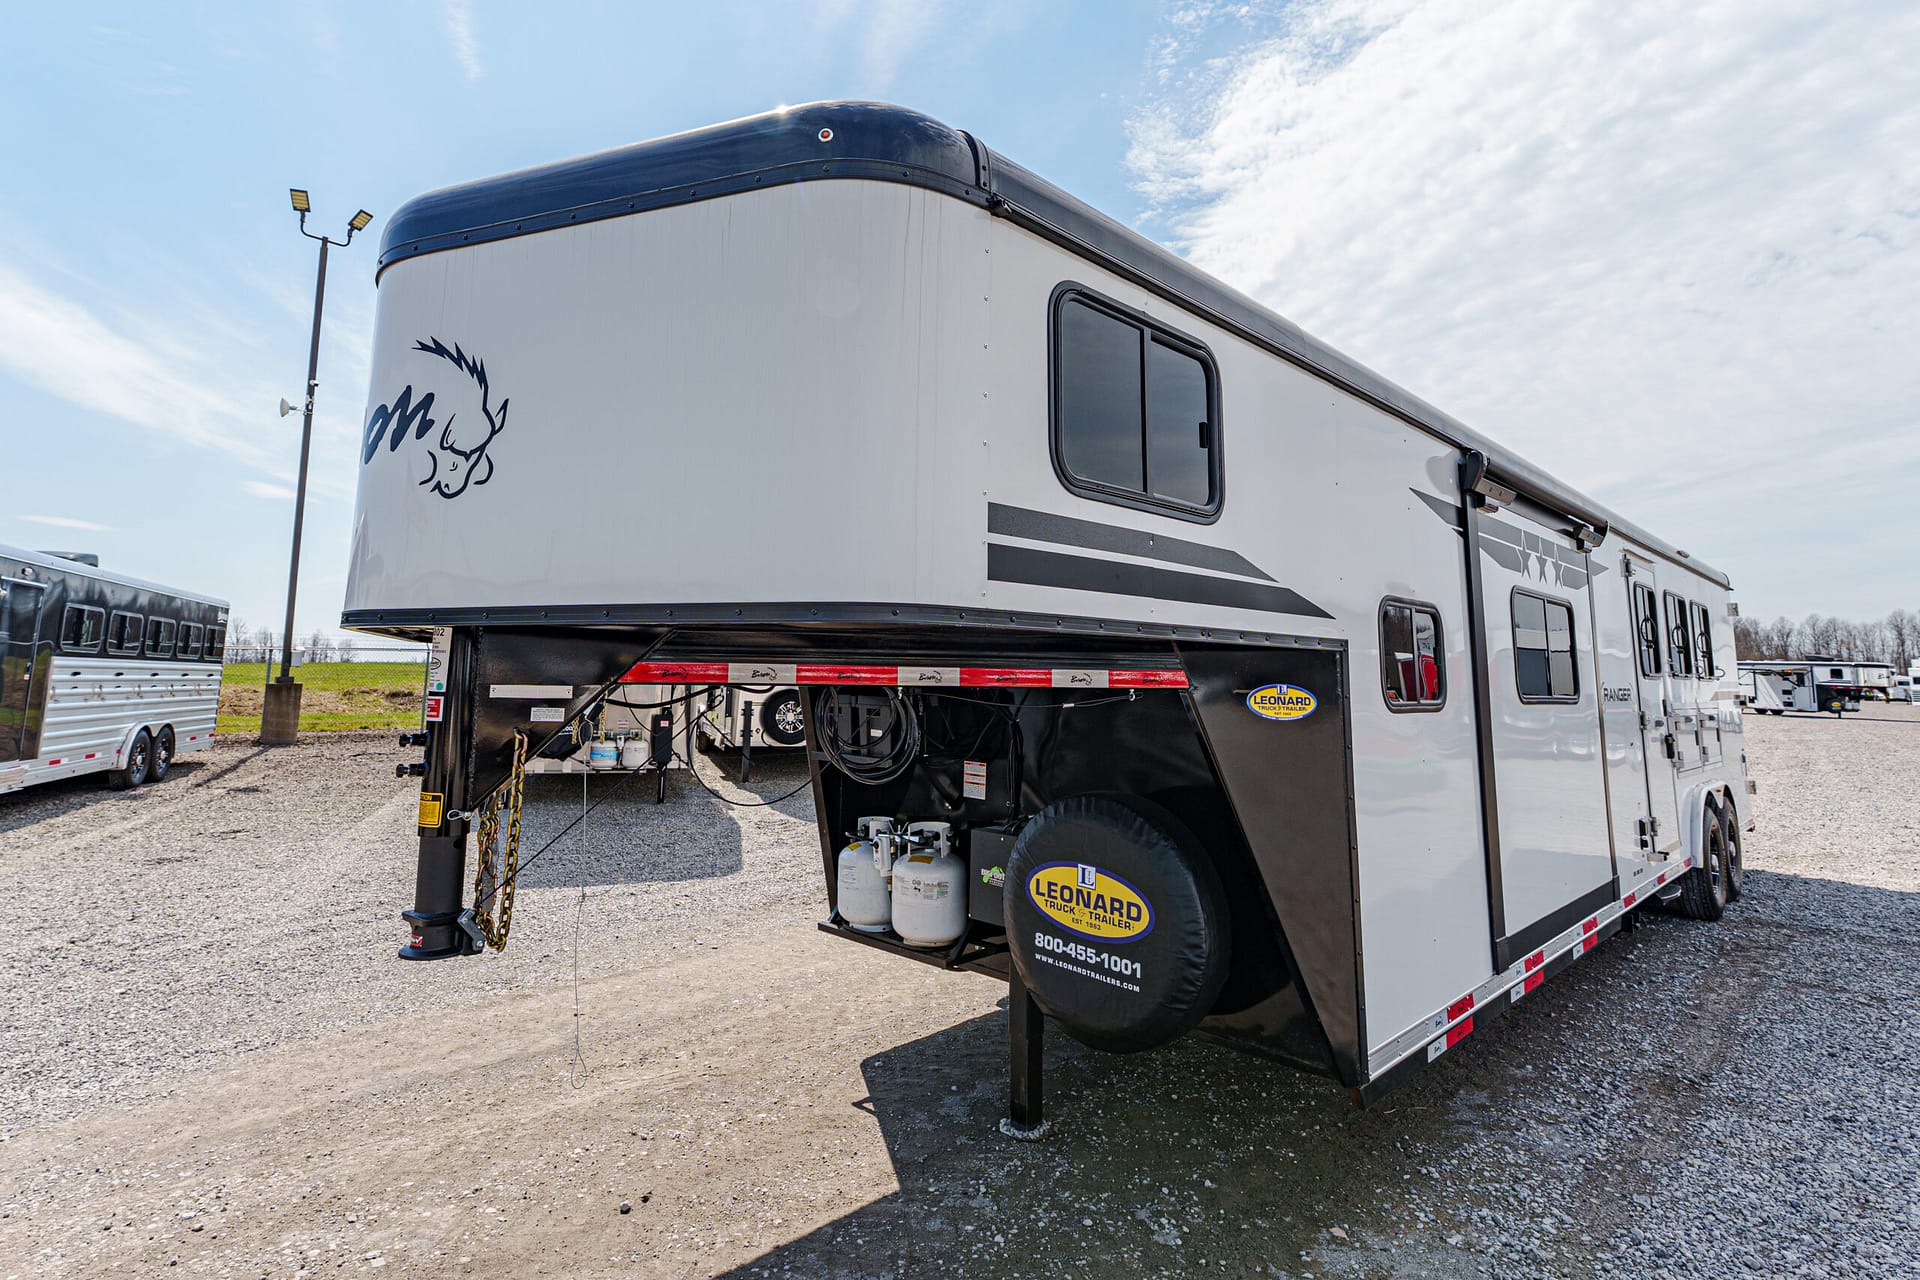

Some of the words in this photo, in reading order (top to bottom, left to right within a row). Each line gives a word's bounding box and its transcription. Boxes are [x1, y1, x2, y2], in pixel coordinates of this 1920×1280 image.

[1253, 695, 1311, 706] LEONARD
[1603, 687, 1632, 702] RANGER
[1035, 878, 1143, 922] LEONARD
[1043, 898, 1076, 916] TRUCK
[1088, 910, 1131, 931] TRAILER
[1071, 917, 1083, 925] EST
[1034, 932, 1142, 979] 800-455-1001
[1034, 953, 1141, 993] WWW.LEONARDTRAILERS.COM
